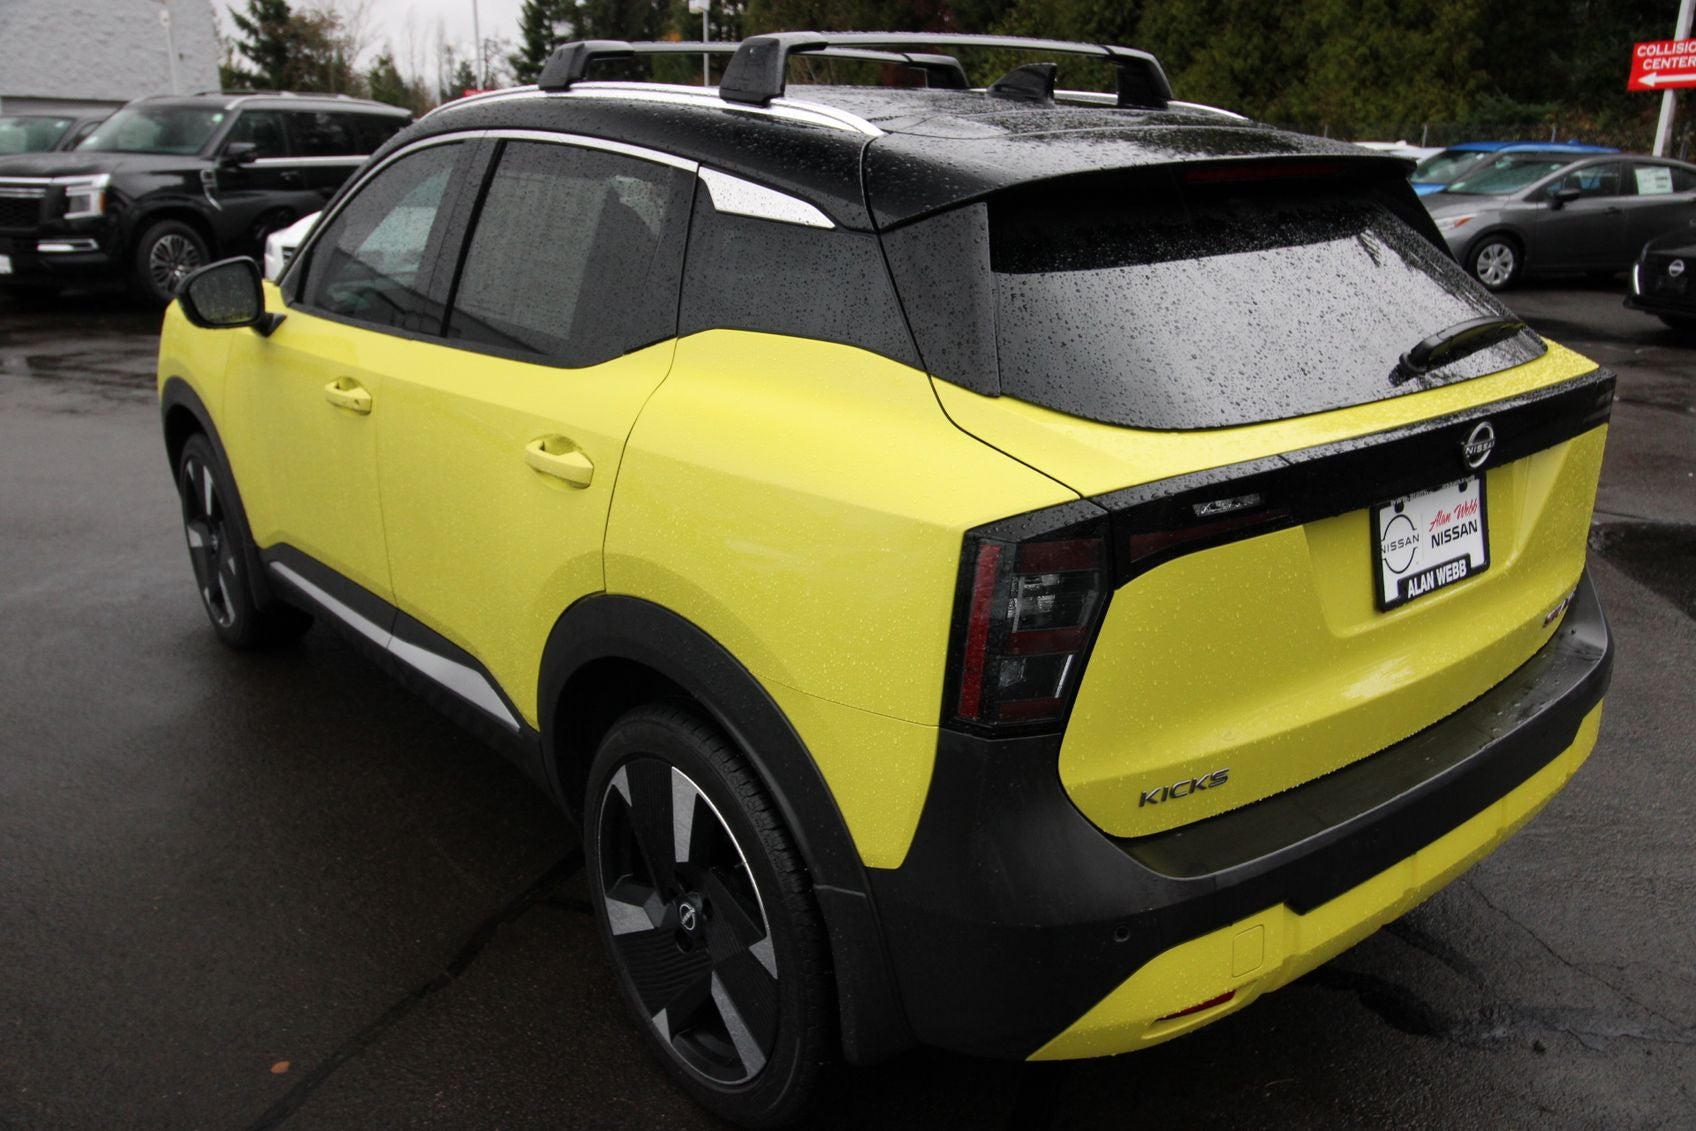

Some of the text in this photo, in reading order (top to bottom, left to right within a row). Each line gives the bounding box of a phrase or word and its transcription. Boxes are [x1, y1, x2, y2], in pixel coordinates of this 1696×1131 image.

[1642, 55, 1696, 70] CENTER
[1429, 498, 1478, 532] Alan Webb
[1431, 520, 1478, 549] NISSAN
[1408, 559, 1467, 599] ALAN WEBB
[1138, 767, 1230, 808] KICKS
